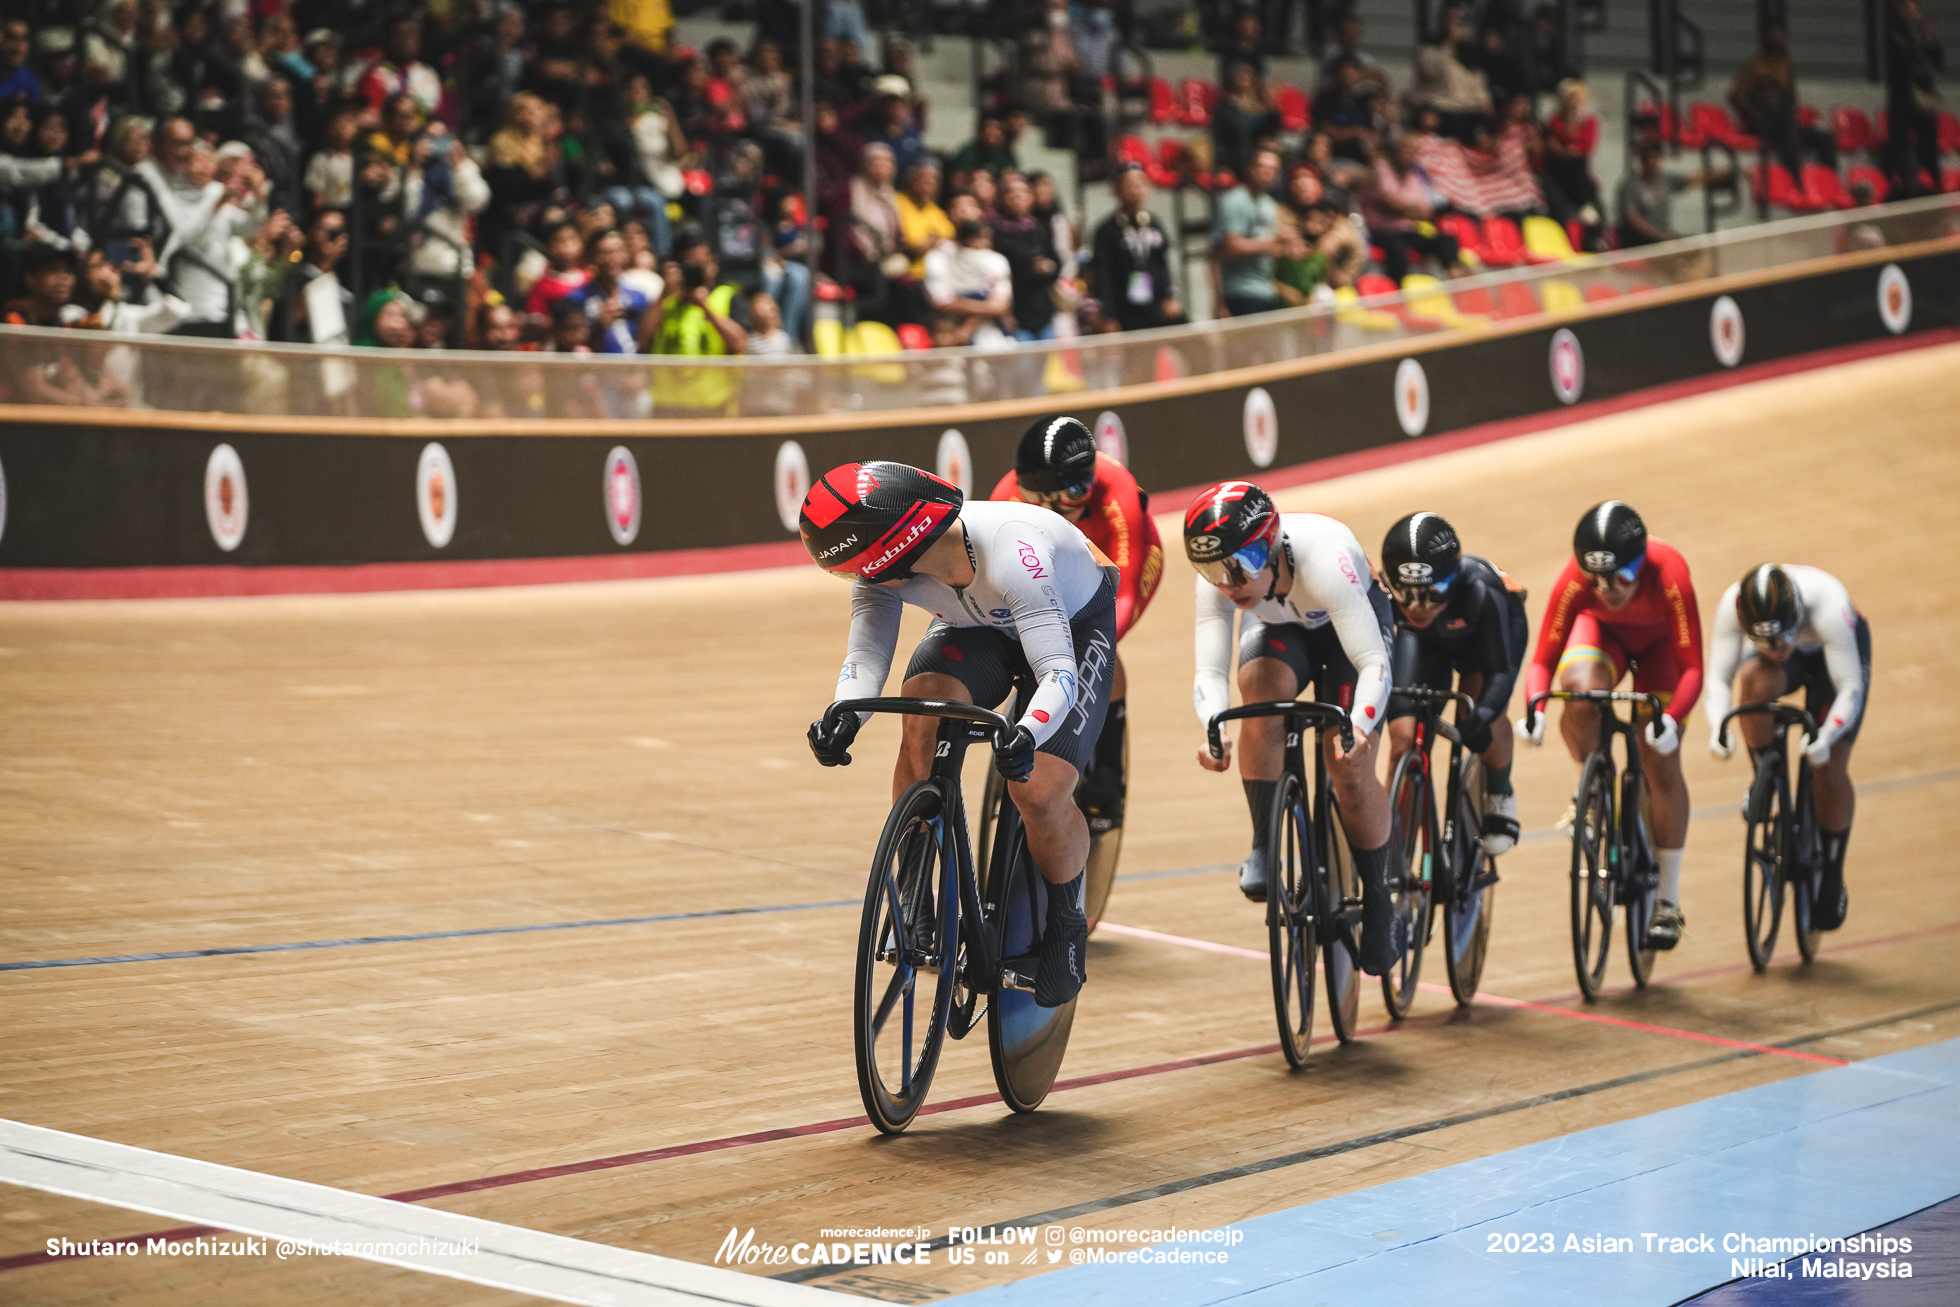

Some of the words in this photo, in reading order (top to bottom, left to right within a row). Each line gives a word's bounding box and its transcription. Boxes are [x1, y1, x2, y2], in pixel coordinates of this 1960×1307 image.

[819, 534, 858, 559] JAPAN
[861, 515, 932, 574] Kabuto
[1073, 629, 1110, 735] JAPAN
